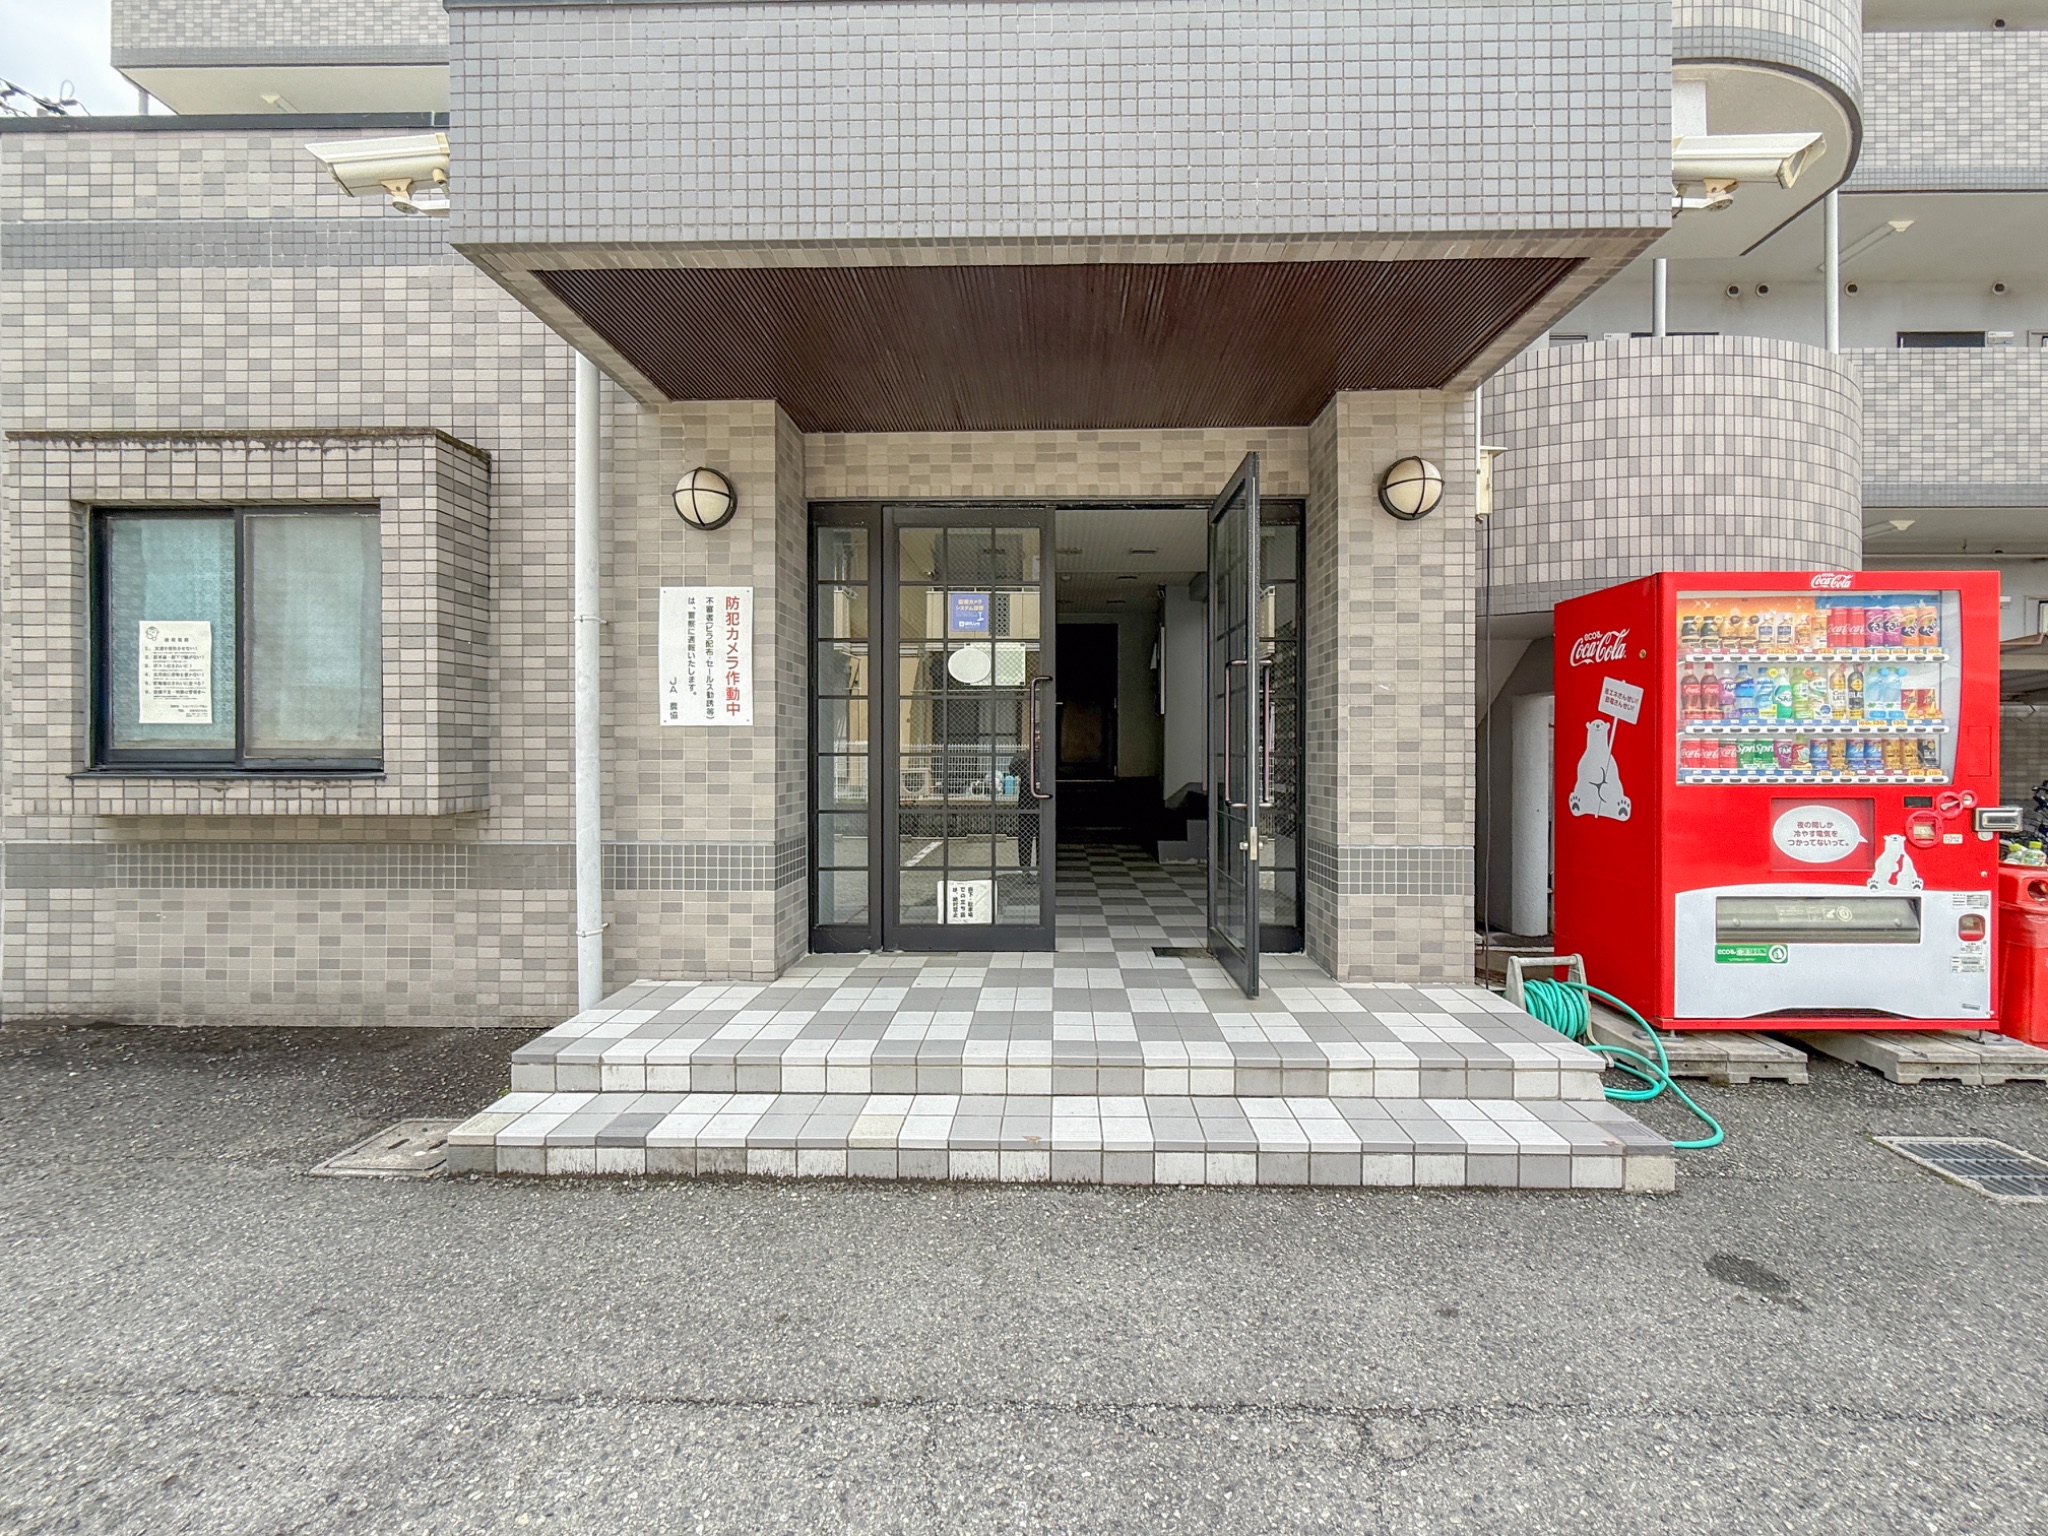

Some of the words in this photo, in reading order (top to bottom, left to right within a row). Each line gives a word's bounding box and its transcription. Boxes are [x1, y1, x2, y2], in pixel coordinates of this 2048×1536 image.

[1810, 574, 1854, 589] Coca-Cola
[687, 597, 697, 696] は、警察に通報いたします。
[1570, 628, 1630, 667] Coca-Cola
[725, 596, 741, 717] 防犯カメラ作動中
[1796, 821, 1834, 829] 夜の間しか
[1793, 830, 1838, 838] 冷やす電気を
[1788, 839, 1849, 847] つかってないって。
